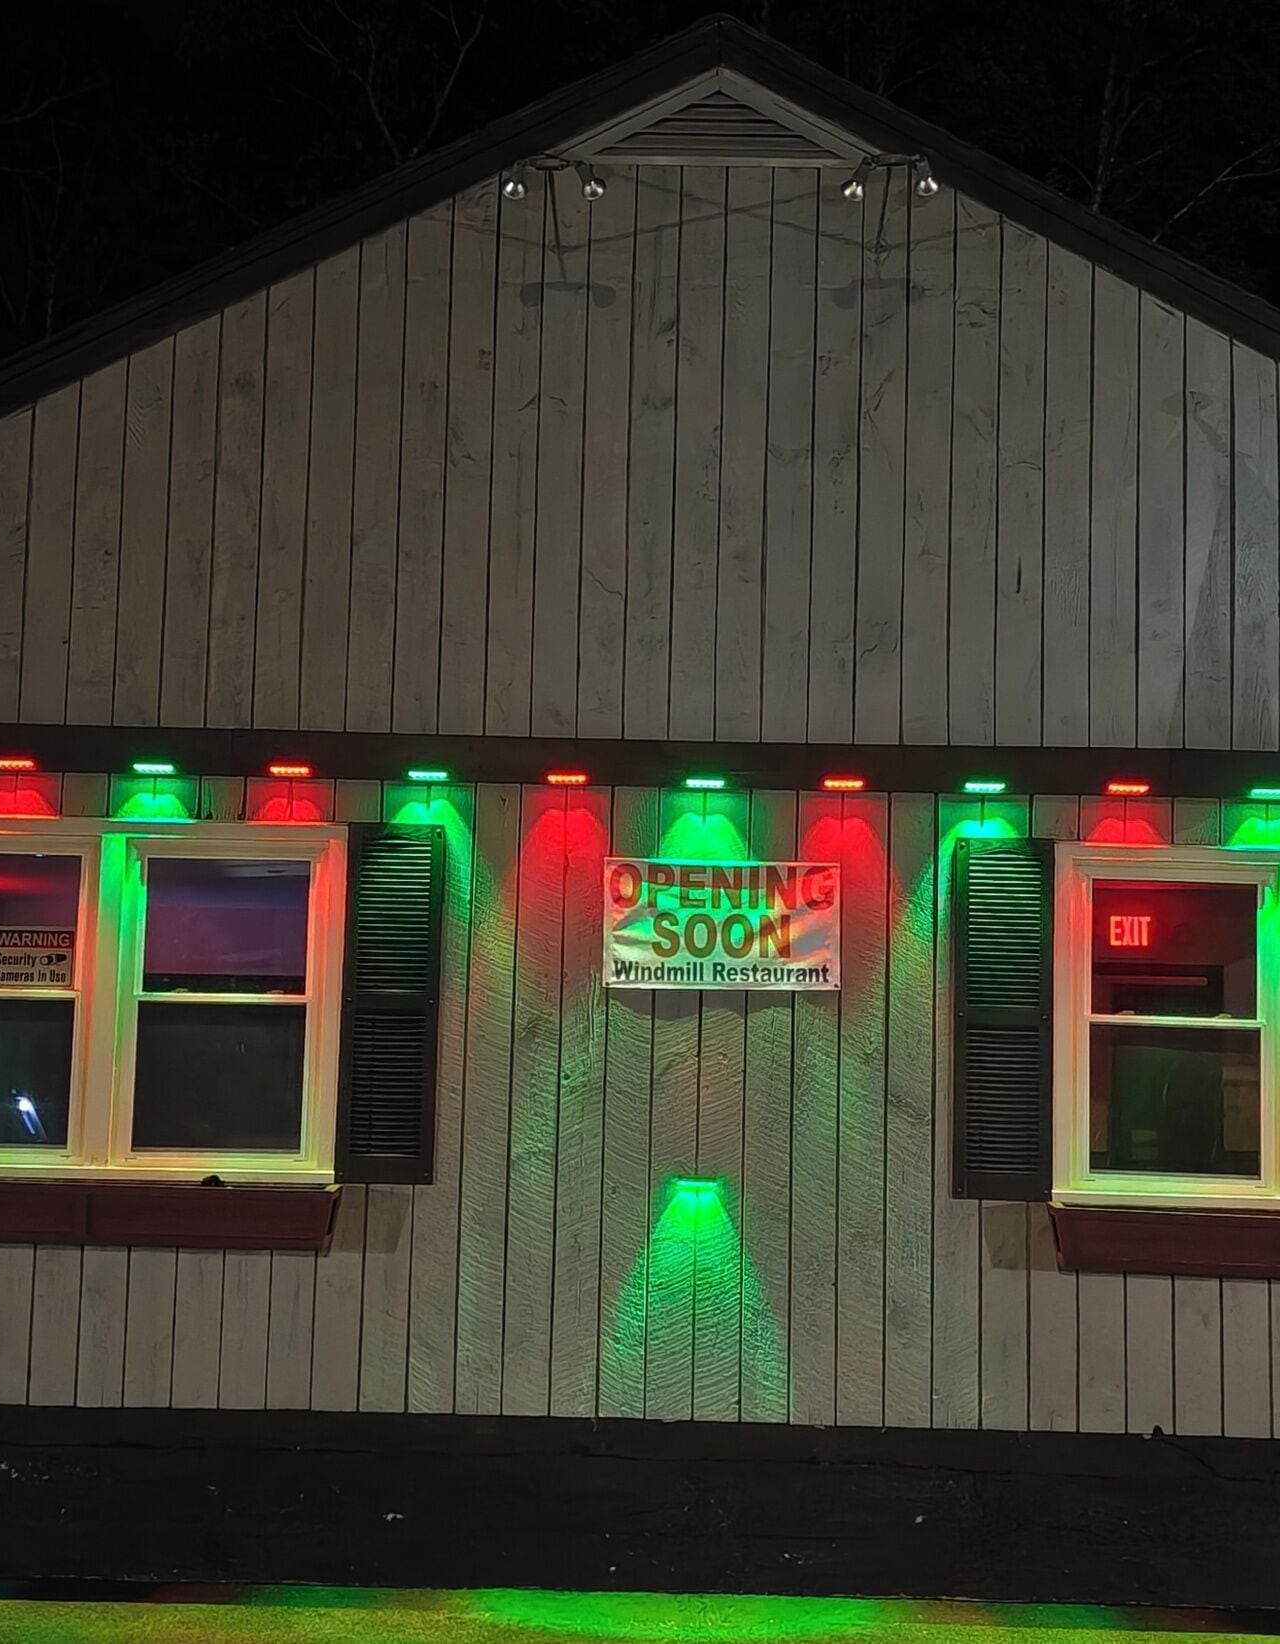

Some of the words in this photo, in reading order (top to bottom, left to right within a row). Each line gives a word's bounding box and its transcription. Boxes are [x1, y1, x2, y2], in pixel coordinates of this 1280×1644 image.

[609, 863, 835, 911] OPENING
[651, 912, 792, 958] SOON
[1110, 916, 1151, 946] EXIT
[38, 970, 47, 982] In
[49, 970, 66, 983] Use
[613, 960, 704, 982] Windmill
[712, 962, 829, 983] Restaurant
